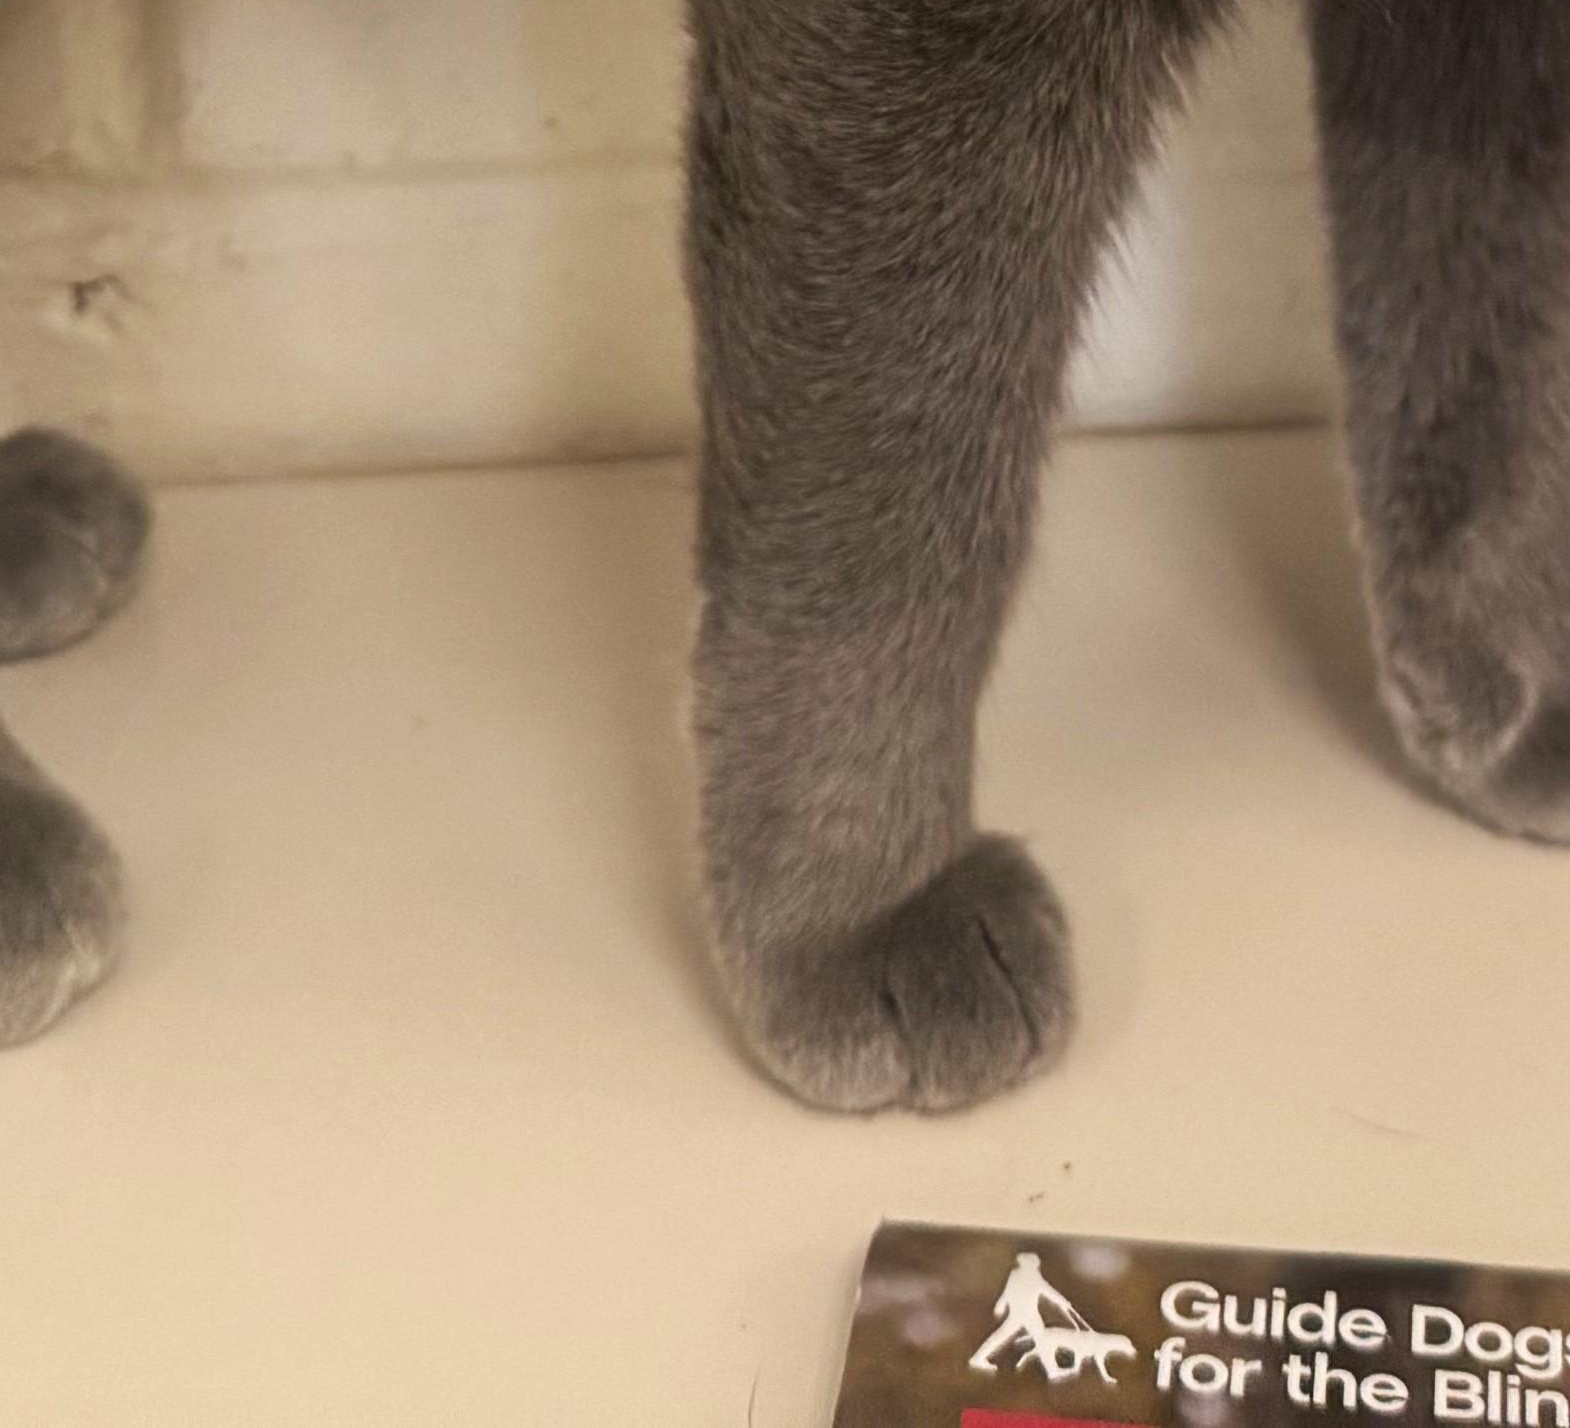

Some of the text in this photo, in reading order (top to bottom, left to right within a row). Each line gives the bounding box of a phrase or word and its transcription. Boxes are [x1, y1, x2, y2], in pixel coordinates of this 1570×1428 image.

[1160, 1279, 1388, 1349] Guide
[1153, 1337, 1261, 1396] for
[1283, 1351, 1409, 1414] the
